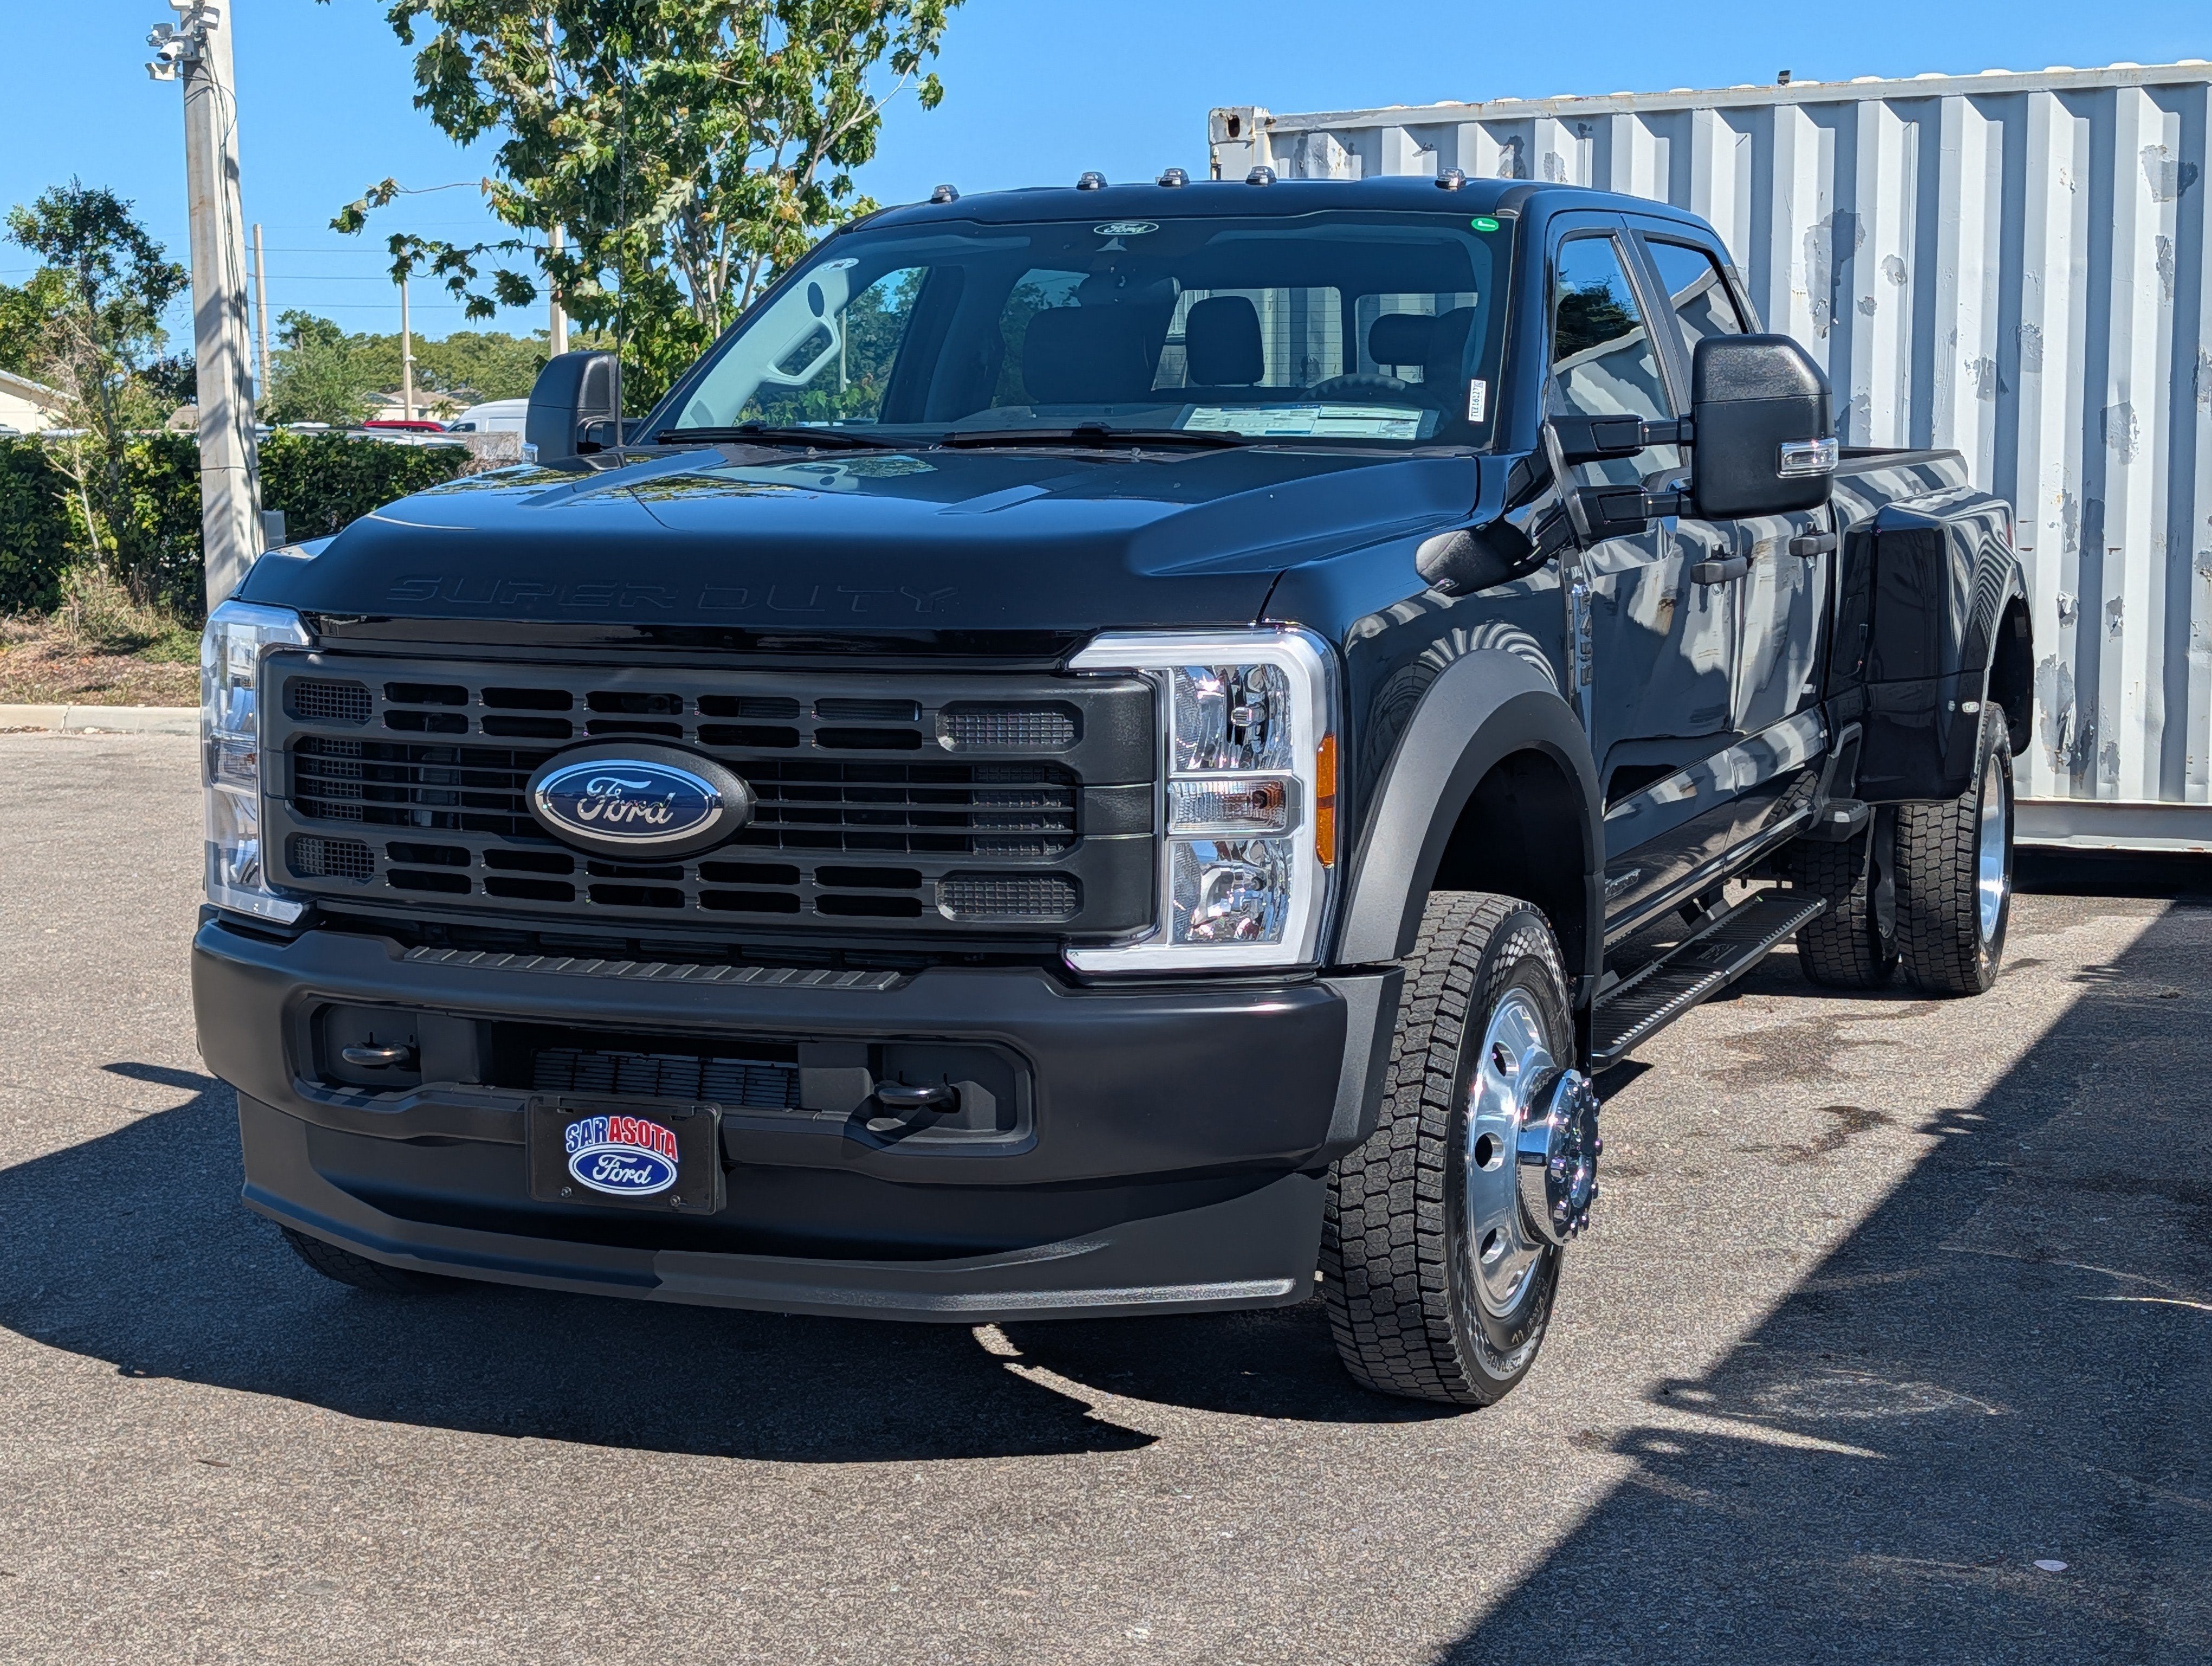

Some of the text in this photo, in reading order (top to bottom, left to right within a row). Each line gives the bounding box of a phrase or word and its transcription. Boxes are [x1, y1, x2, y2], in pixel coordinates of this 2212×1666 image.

[386, 575, 959, 613] SUPER DUTY
[577, 776, 676, 825] Ford
[565, 1115, 679, 1163] SARASOTA
[592, 1154, 653, 1184] Ford
